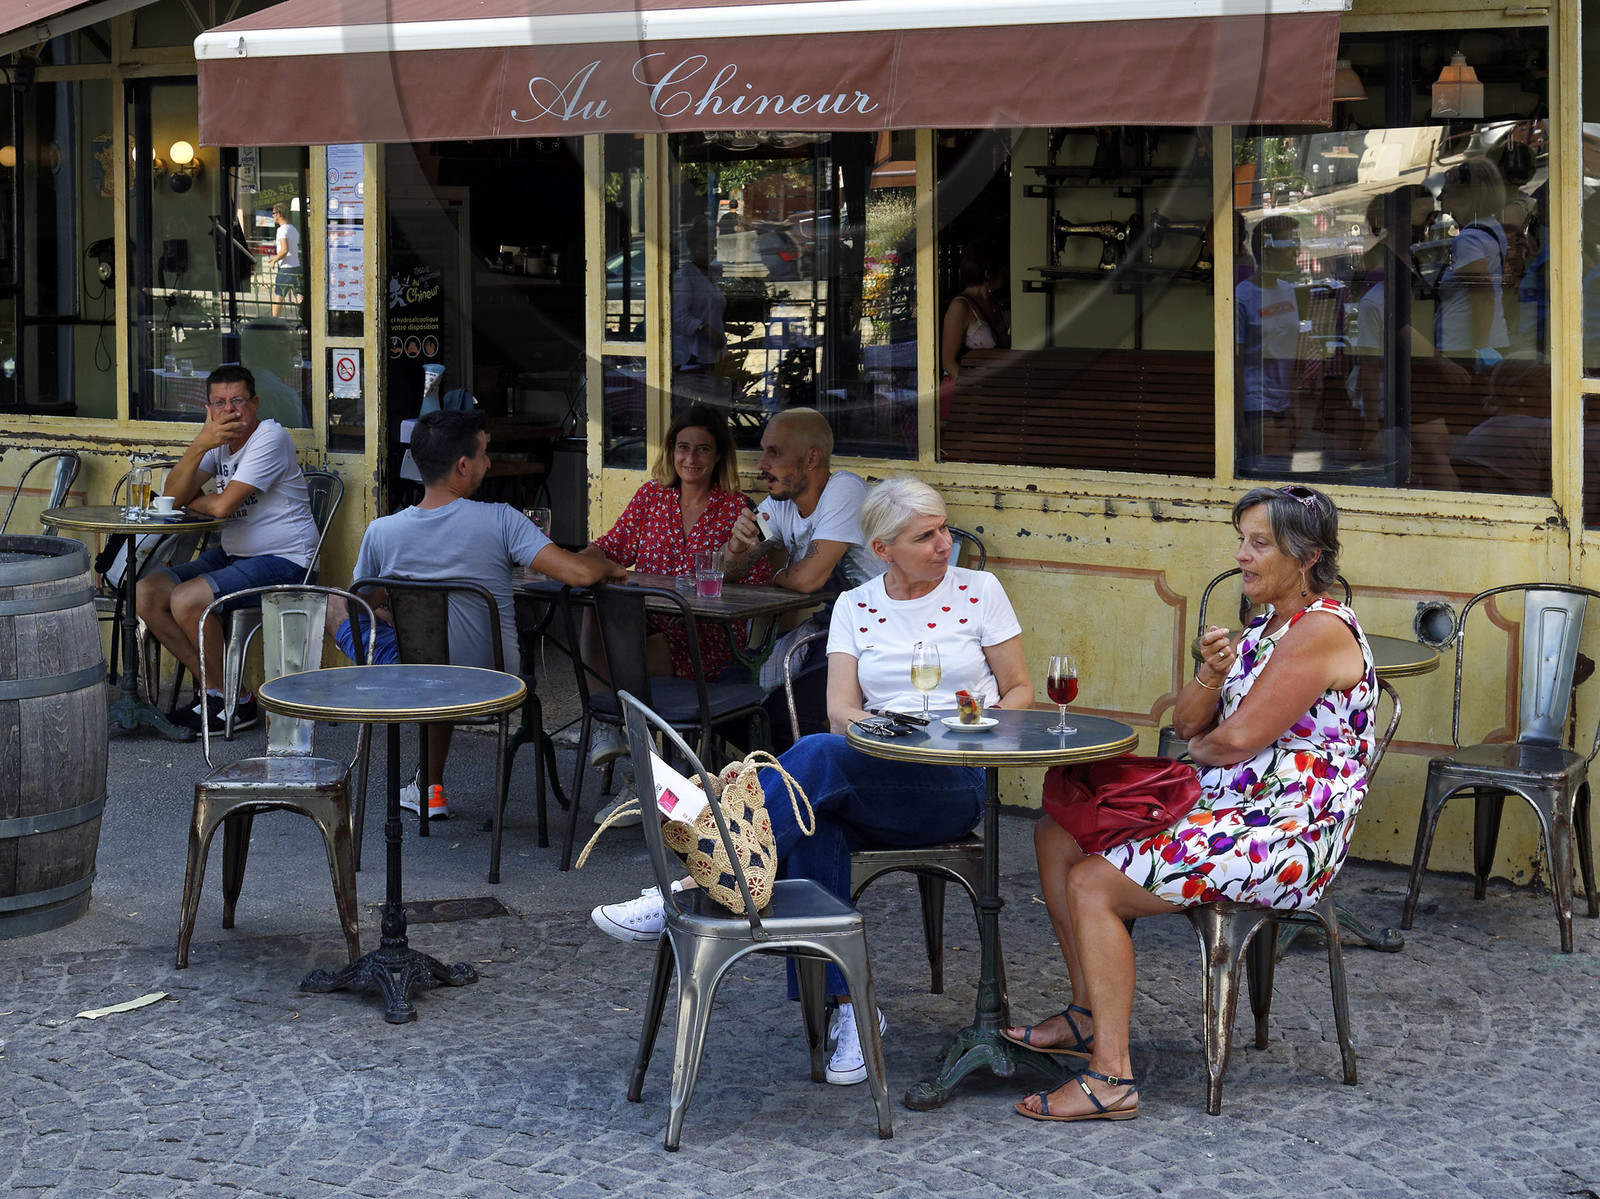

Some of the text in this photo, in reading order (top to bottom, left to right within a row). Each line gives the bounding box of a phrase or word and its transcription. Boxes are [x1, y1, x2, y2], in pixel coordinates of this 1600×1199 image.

[511, 52, 880, 123] Au Chineur
[406, 285, 439, 303] Chineur
[397, 316, 439, 324] hydroalcoolique
[391, 323, 439, 332] votre disposition
